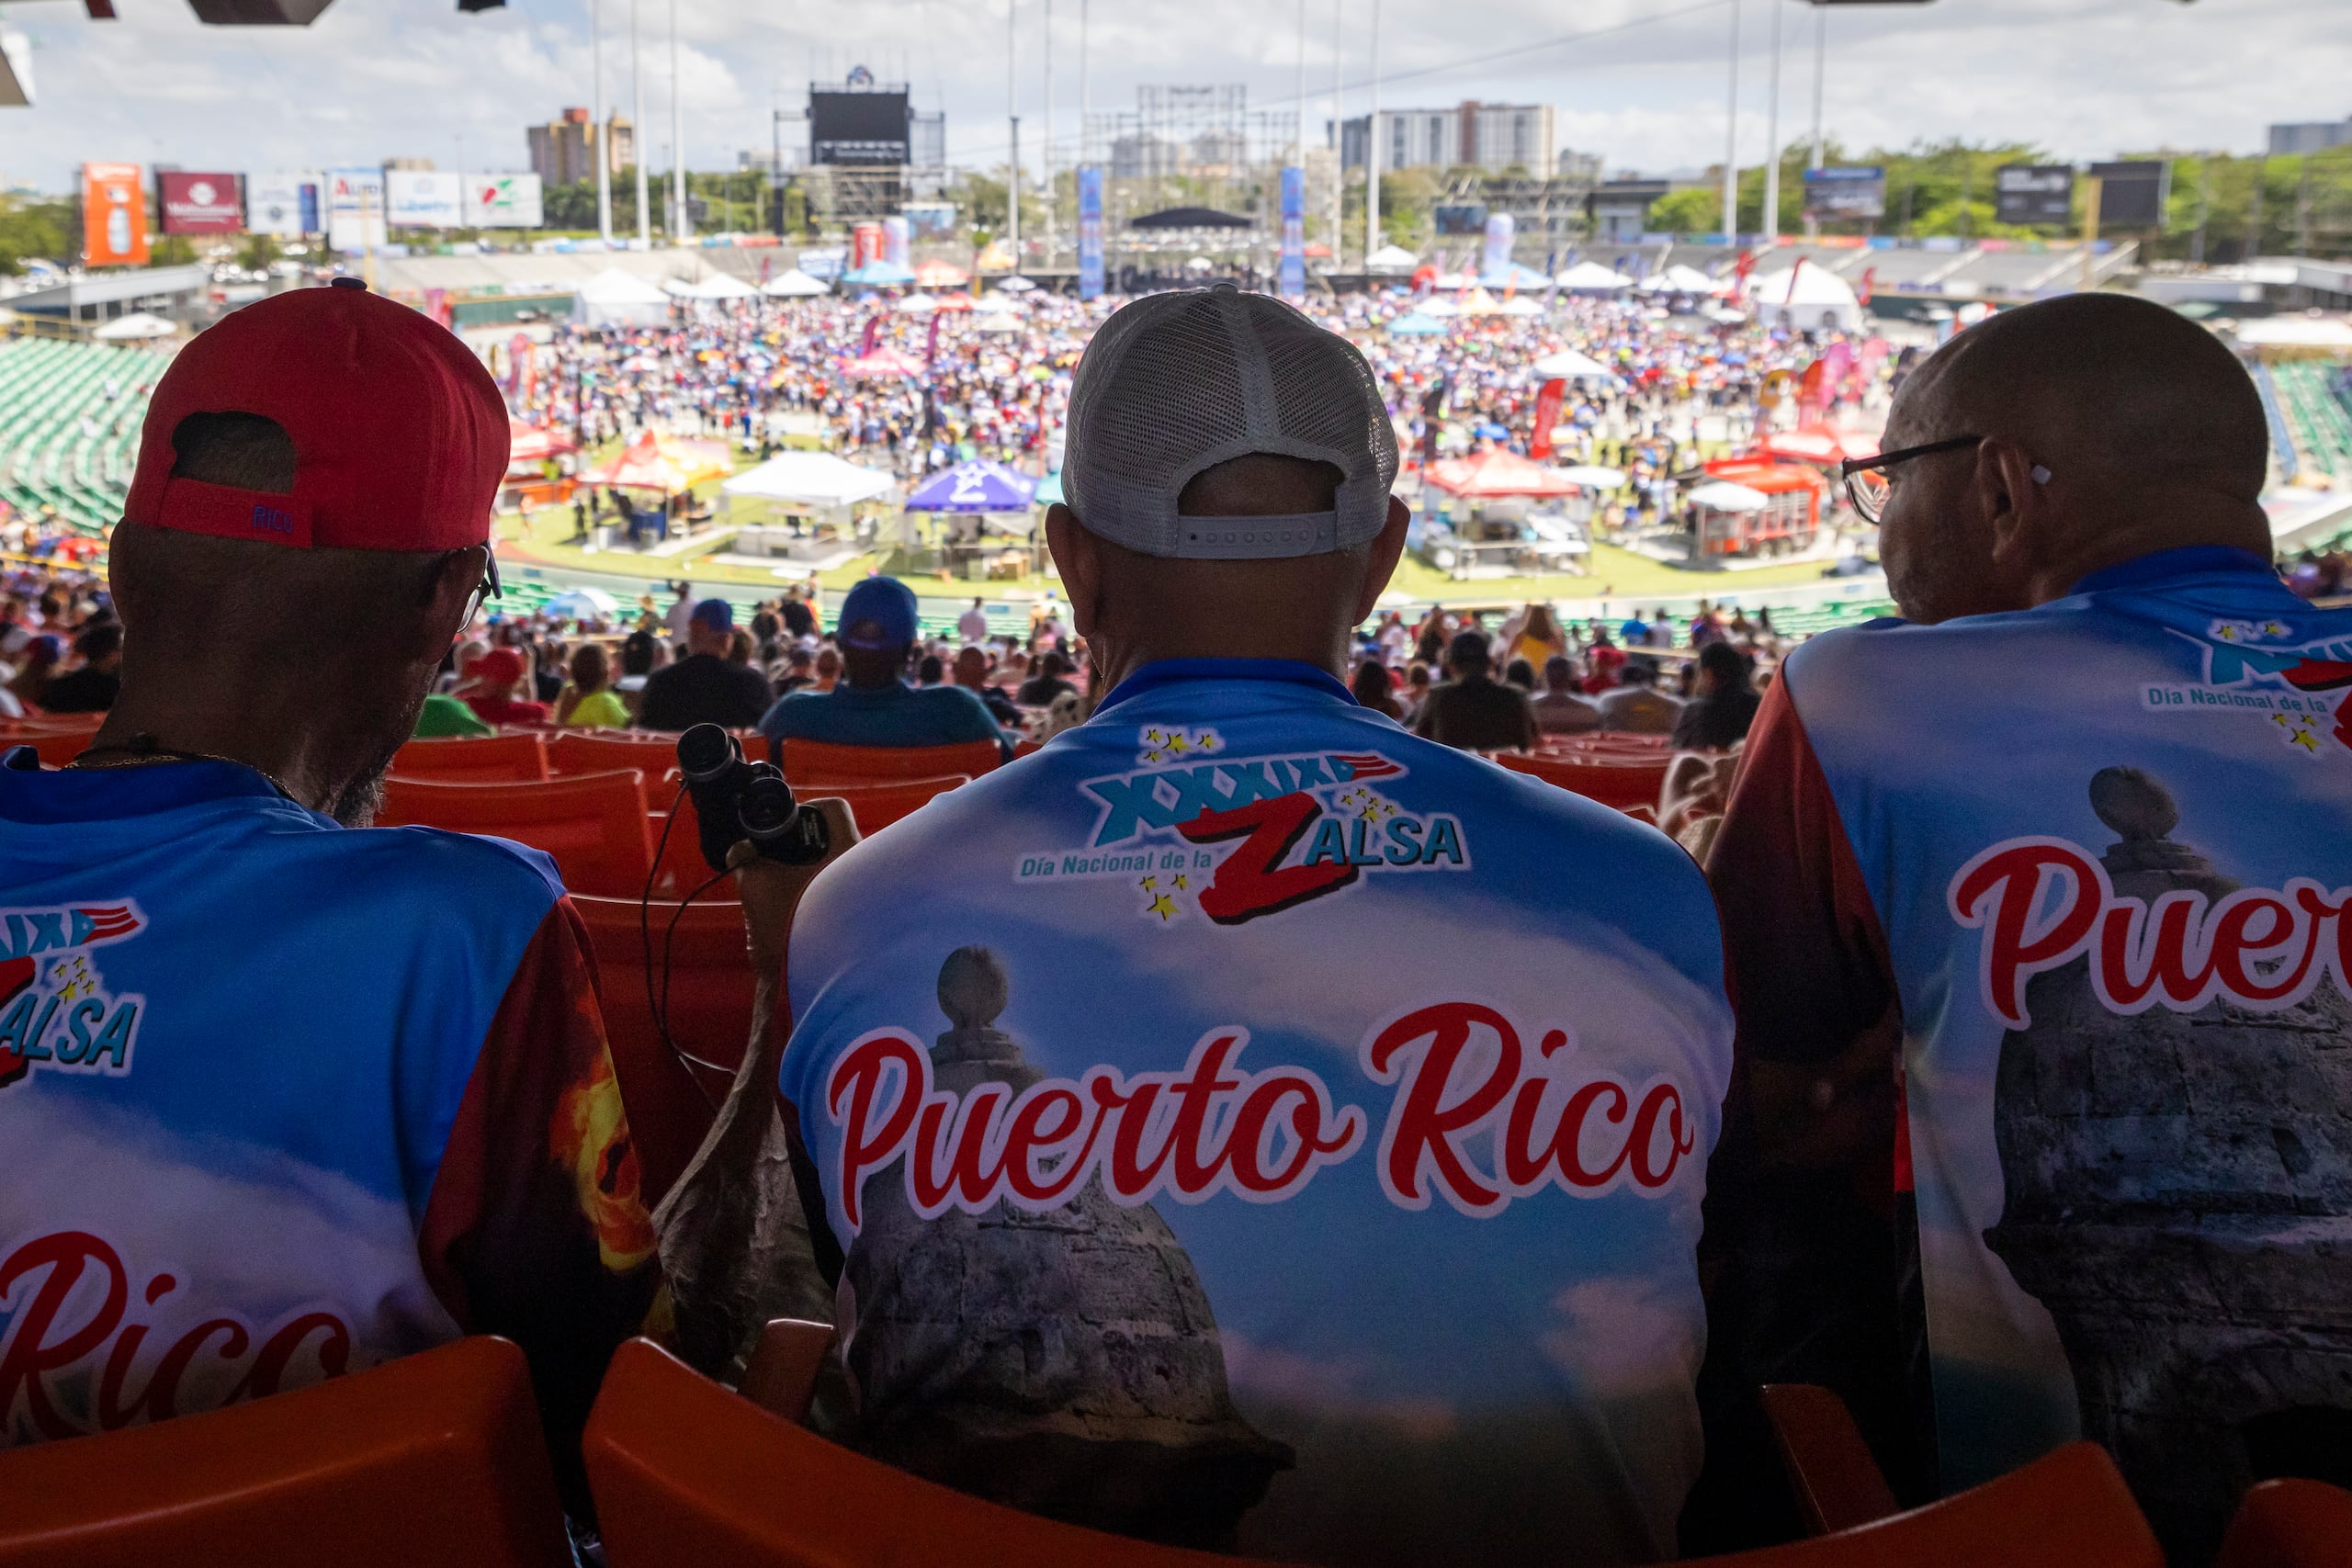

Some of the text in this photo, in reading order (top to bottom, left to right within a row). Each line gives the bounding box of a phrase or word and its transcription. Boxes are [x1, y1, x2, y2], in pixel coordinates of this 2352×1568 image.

[253, 505, 294, 534] RICO
[2148, 688, 2328, 714] Día Nacional de la
[1021, 851, 1212, 877] Día Nacional de la
[829, 1002, 1694, 1228] Puerto Rico
